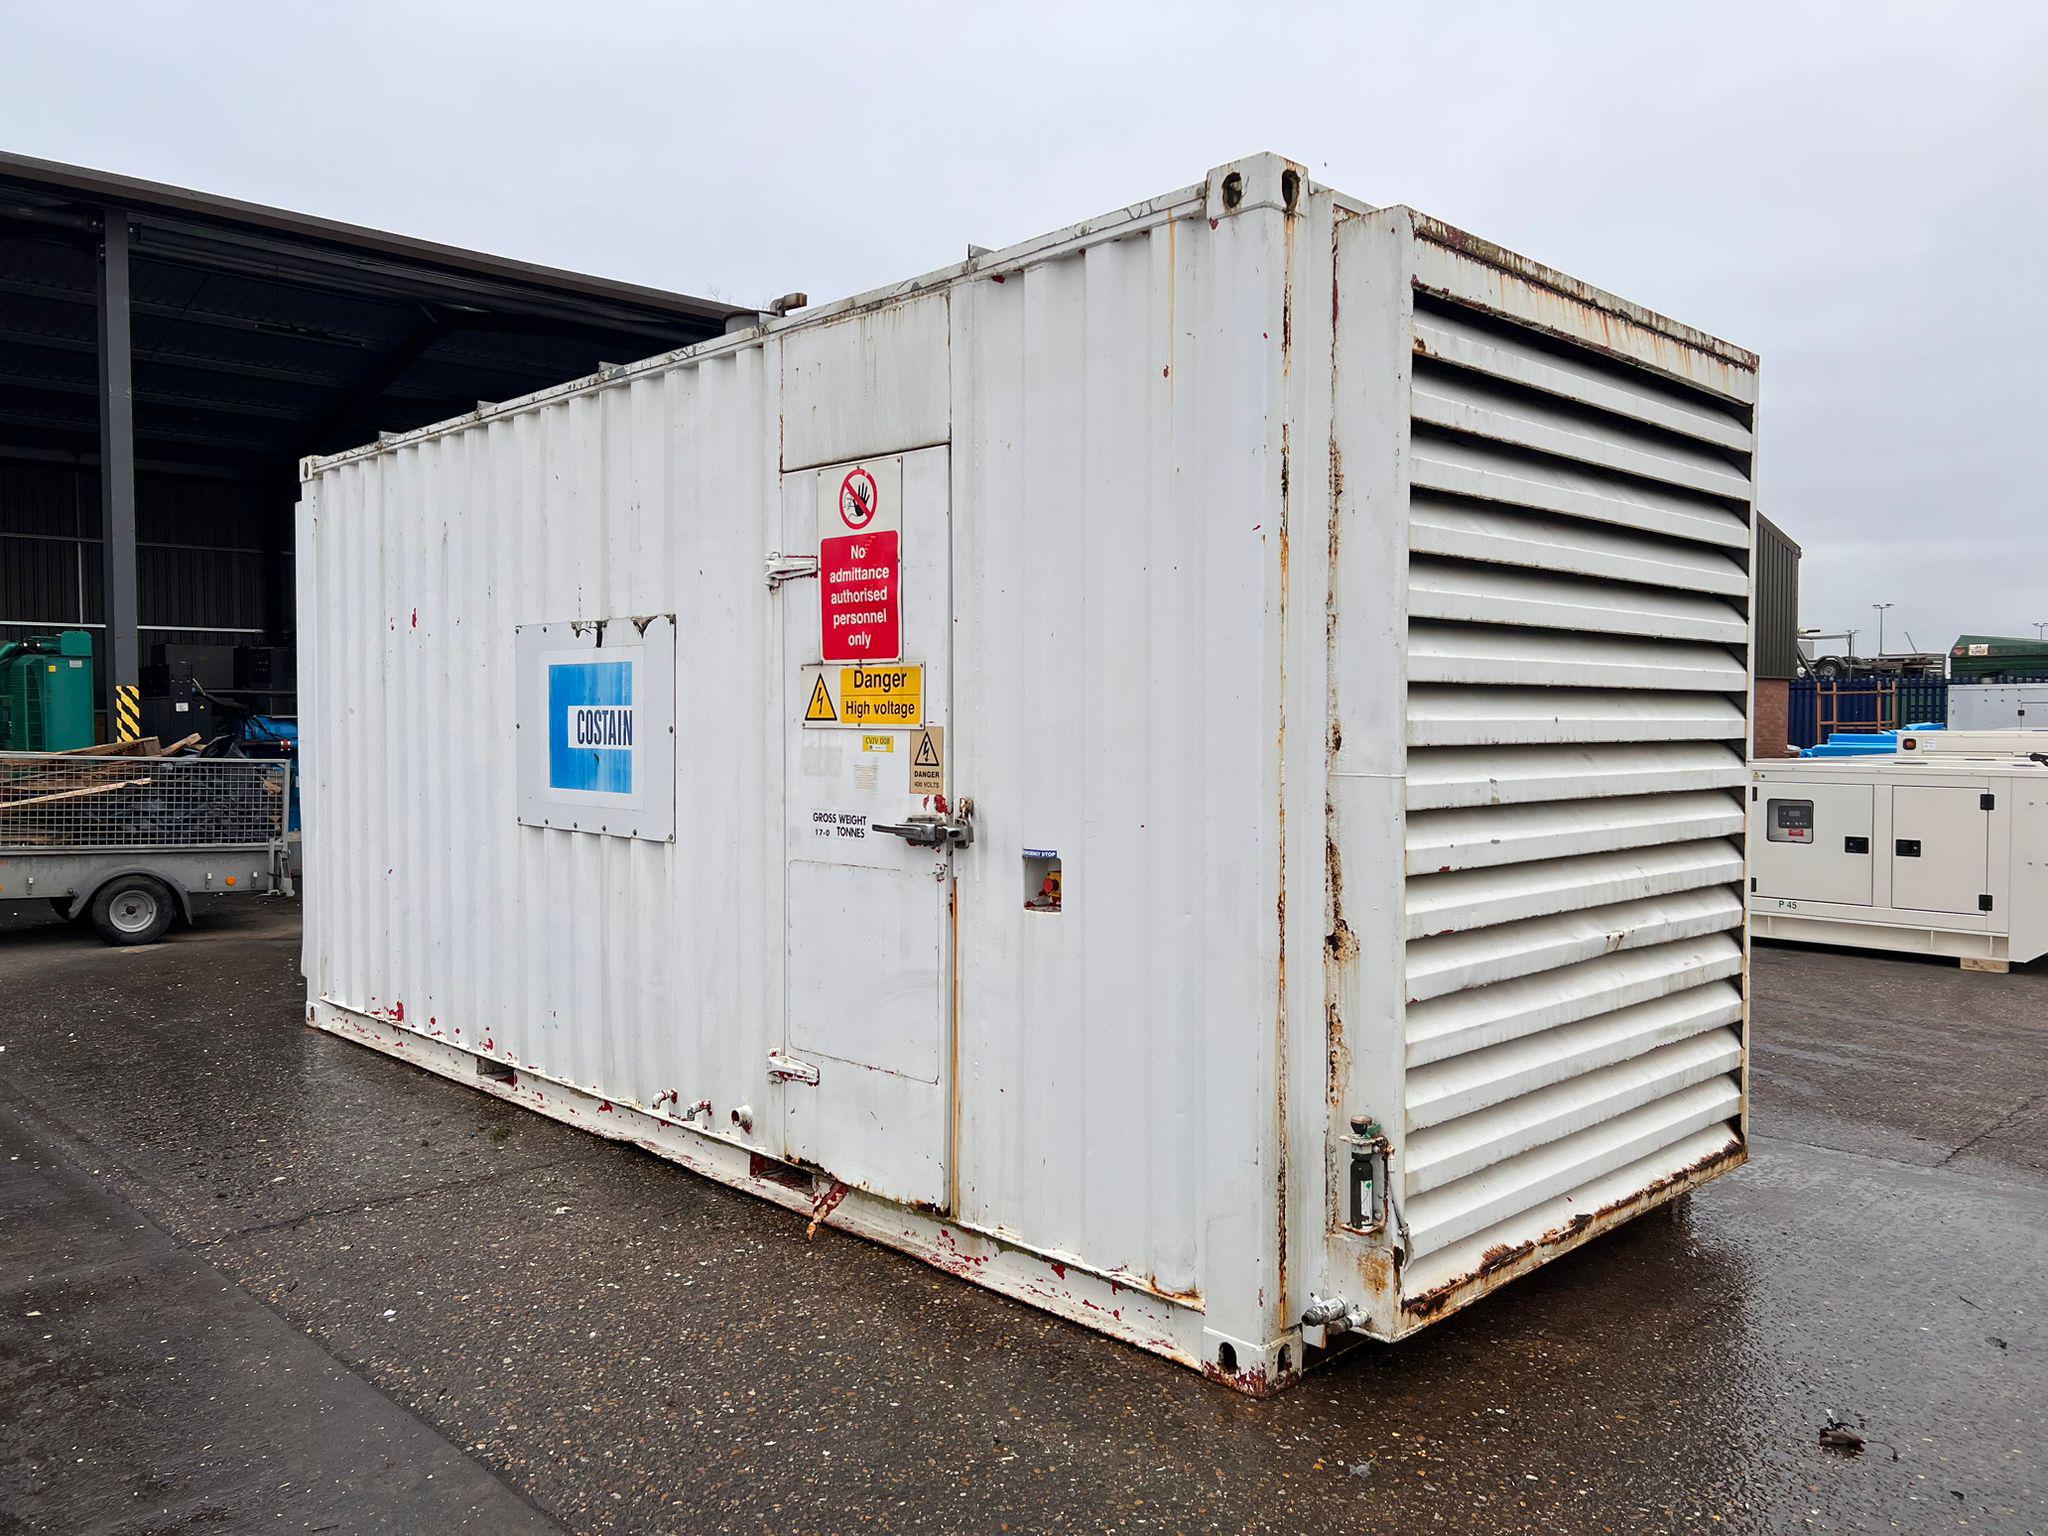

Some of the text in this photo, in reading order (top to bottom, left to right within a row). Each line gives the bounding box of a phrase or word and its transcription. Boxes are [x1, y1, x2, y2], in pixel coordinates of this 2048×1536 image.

[851, 545, 866, 559] No
[829, 566, 890, 583] admittance
[830, 586, 888, 604] authorised
[833, 609, 887, 628] personnel
[848, 631, 871, 649] only
[853, 670, 907, 693] Danger
[845, 700, 915, 718] High voltage
[577, 709, 633, 746] COSTAIN
[813, 812, 867, 826] GROSS WEIGHT
[836, 826, 865, 839] TONNES
[1778, 900, 1797, 910] P 45
